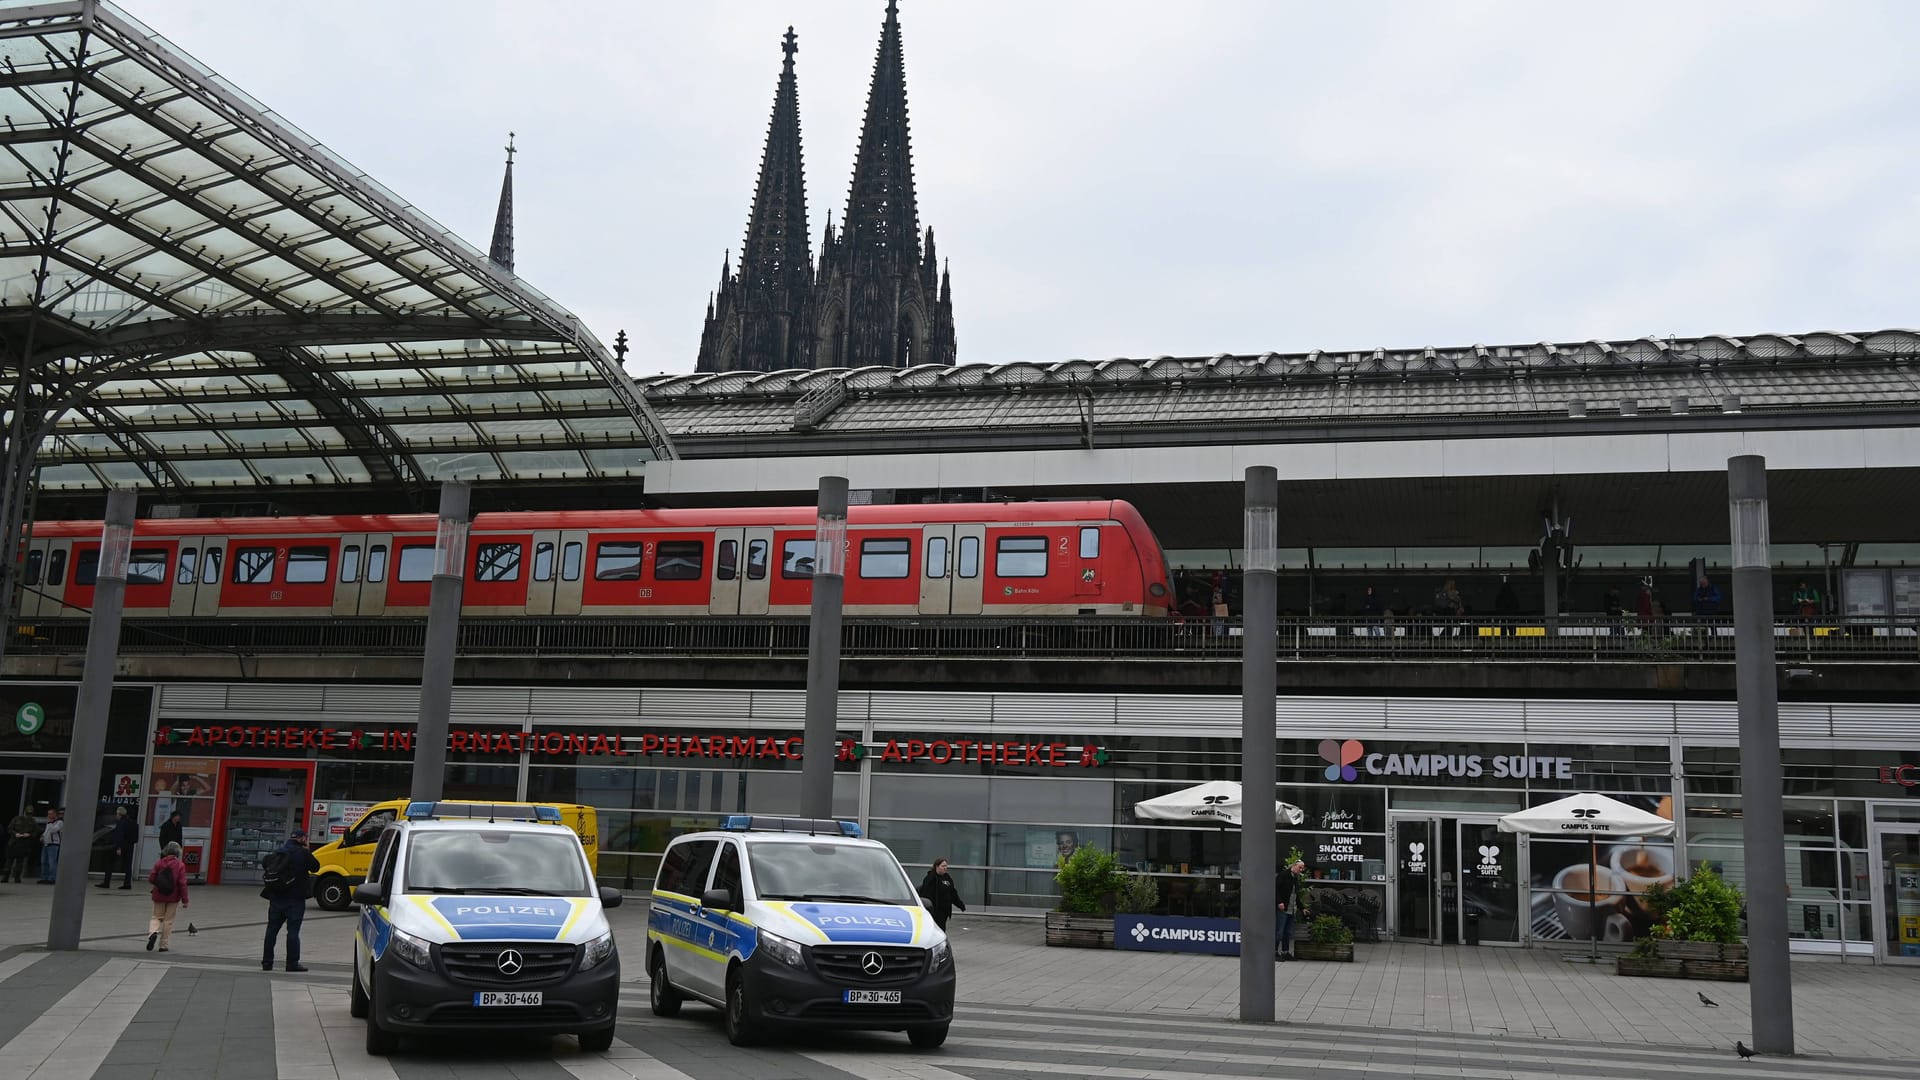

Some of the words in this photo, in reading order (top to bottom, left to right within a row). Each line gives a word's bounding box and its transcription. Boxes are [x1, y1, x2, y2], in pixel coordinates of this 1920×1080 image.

[645, 543, 654, 554] 2
[1060, 537, 1068, 550] 2
[279, 548, 286, 559] 2
[640, 588, 651, 598] DB
[20, 706, 38, 731] S
[188, 725, 337, 750] APOTHEKE
[382, 729, 628, 757] INRNATIONAL
[642, 733, 804, 761] PHARMAC
[881, 739, 1066, 767] APOTHEKE
[1365, 752, 1483, 778] CAMPUS
[1492, 756, 1573, 780] SUITE
[1216, 810, 1232, 820] SUITE
[1330, 822, 1354, 830] JUICE
[1333, 837, 1361, 845] LUNCH
[1319, 845, 1353, 853] SNACKS
[1330, 854, 1363, 862] COFFEE
[457, 906, 556, 916] POLIZEI
[672, 918, 692, 937] POLIZEI
[818, 916, 906, 928] POLIZEI
[1152, 928, 1205, 941] CAMPUS
[1207, 930, 1240, 942] SUITE
[483, 994, 496, 1004] BP
[504, 994, 539, 1004] 30-466
[850, 992, 862, 1001] BP
[868, 992, 900, 1002] 30-465
